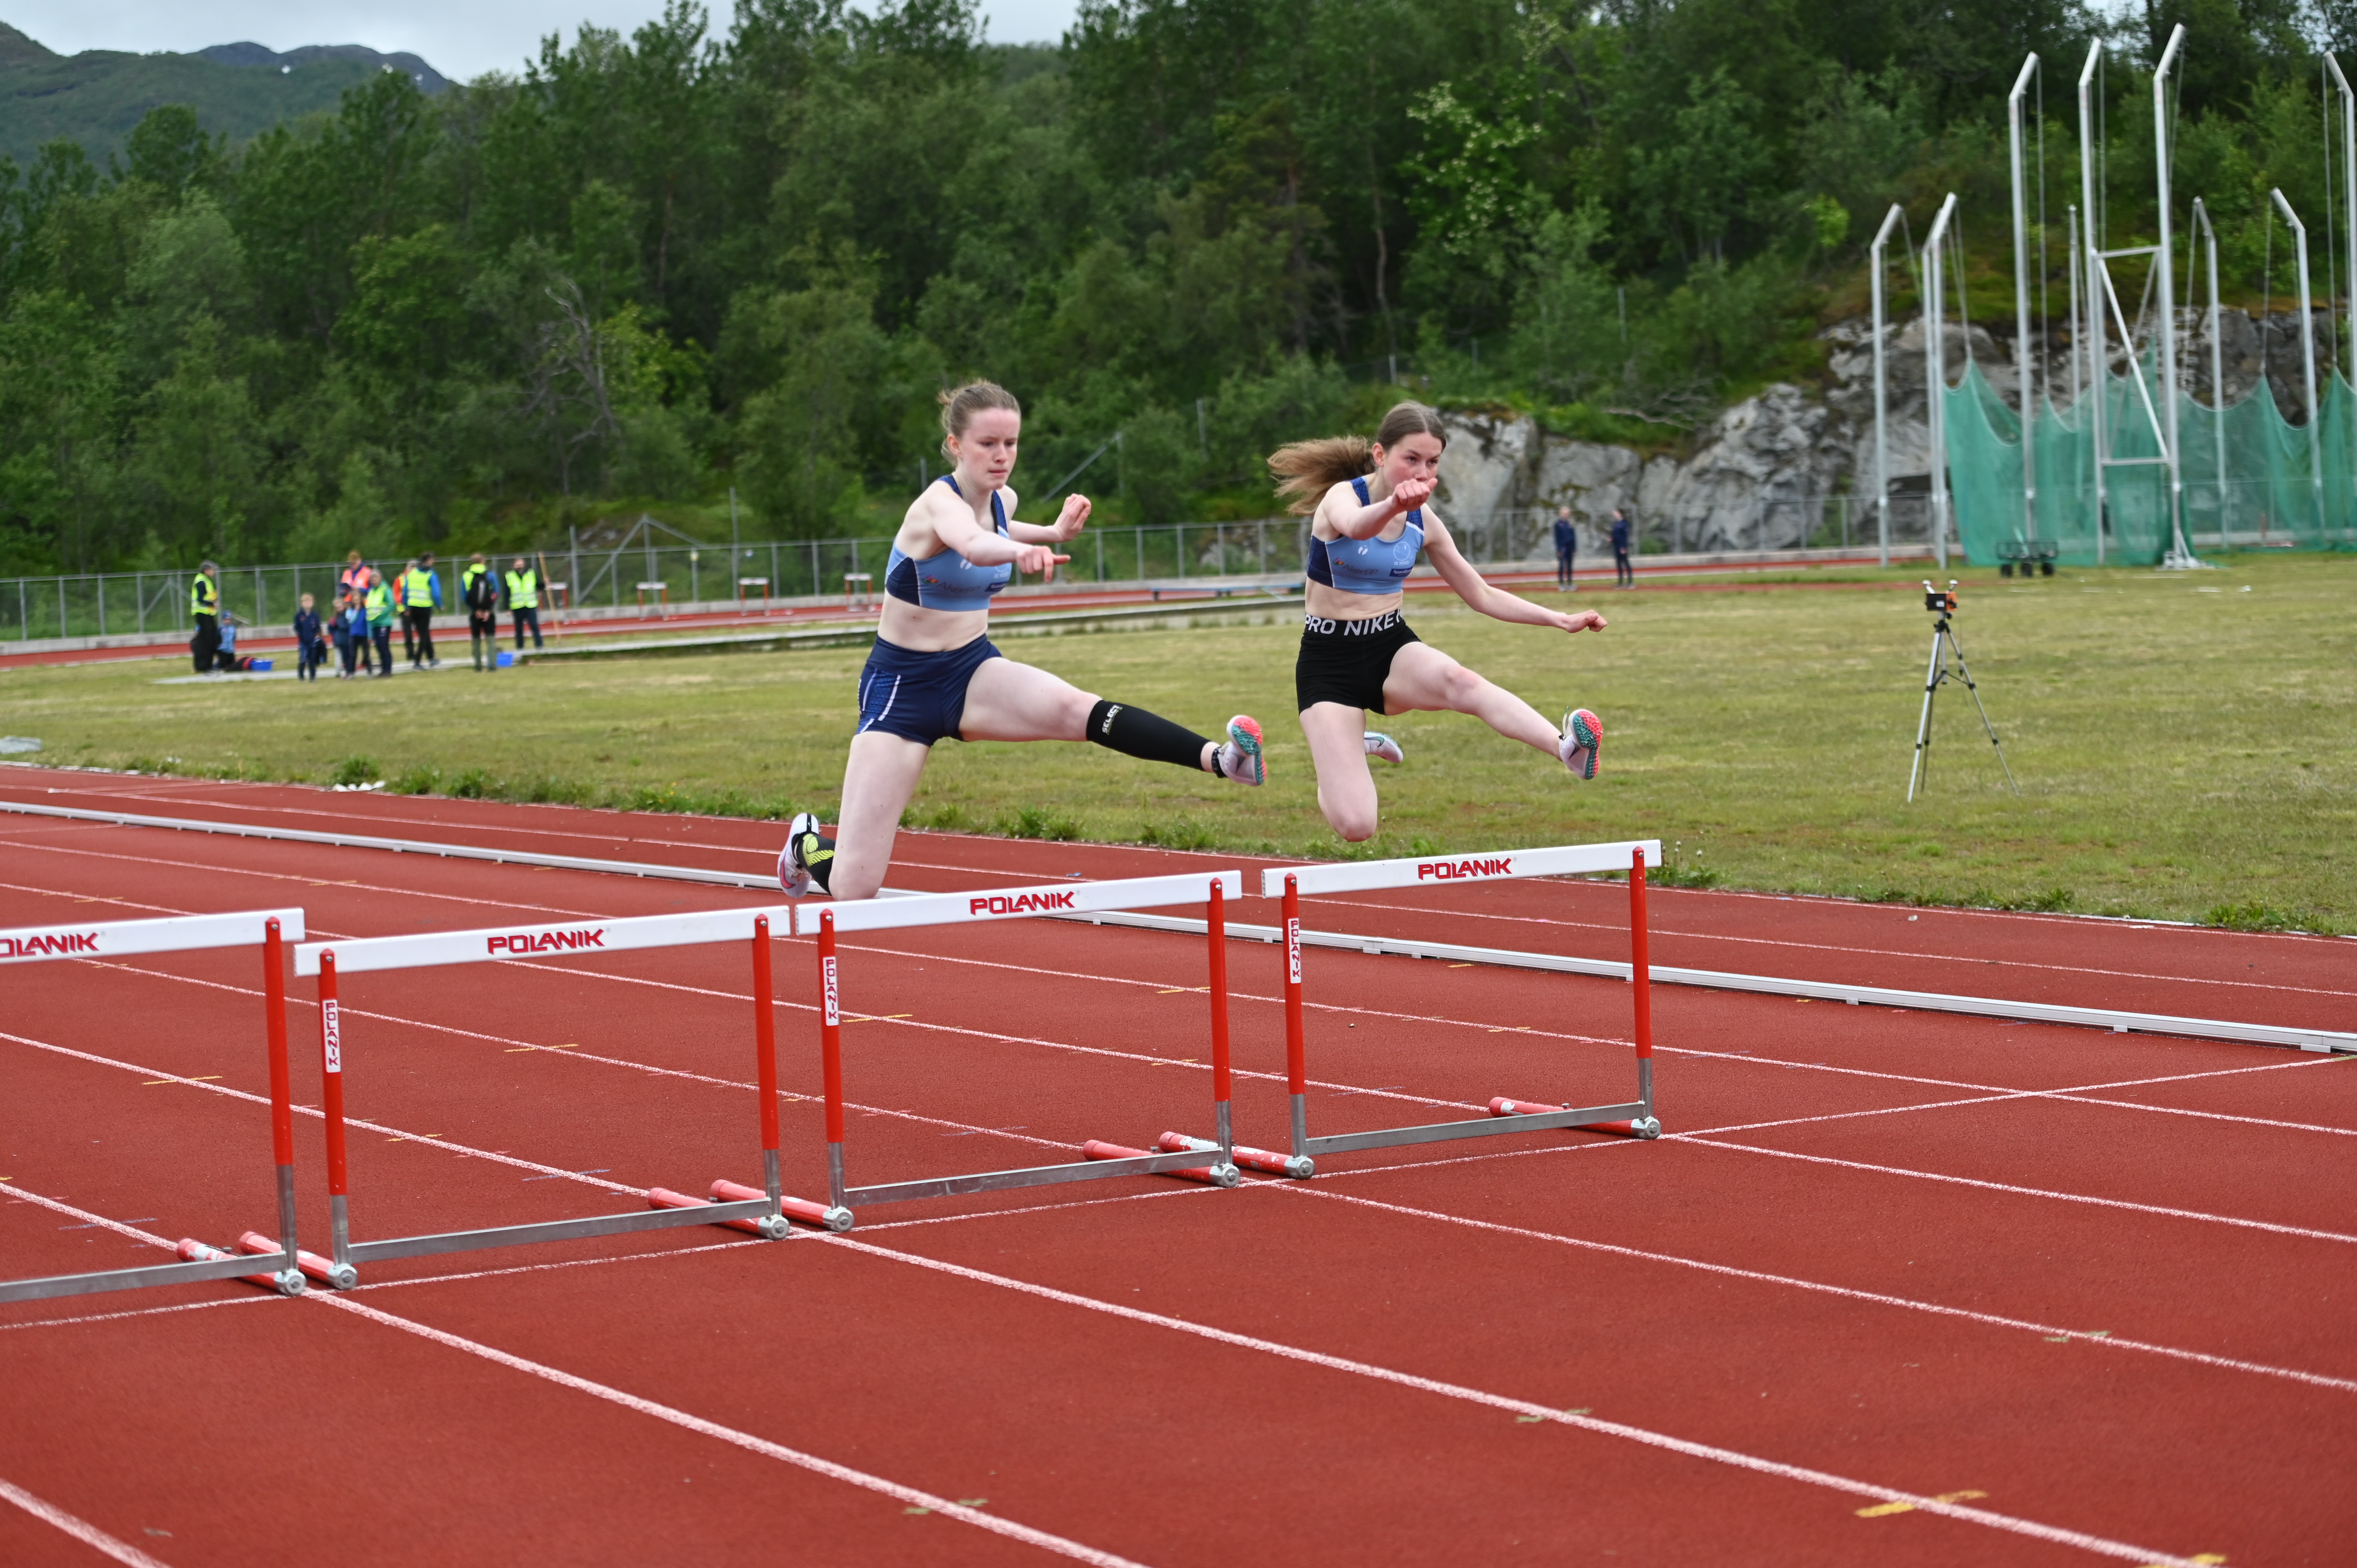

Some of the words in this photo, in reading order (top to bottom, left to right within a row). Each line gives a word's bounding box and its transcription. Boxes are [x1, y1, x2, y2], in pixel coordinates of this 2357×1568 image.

[1306, 614, 1336, 634] PRO
[1344, 611, 1395, 636] NIKE
[1102, 704, 1121, 735] SELECT
[1418, 858, 1512, 881] POLANIK
[970, 891, 1075, 916] POLANIK
[488, 929, 605, 955] POLANIK
[1290, 920, 1300, 977] POLANIK
[826, 959, 837, 1019] POLANIK
[326, 1002, 339, 1066] POLANIK
